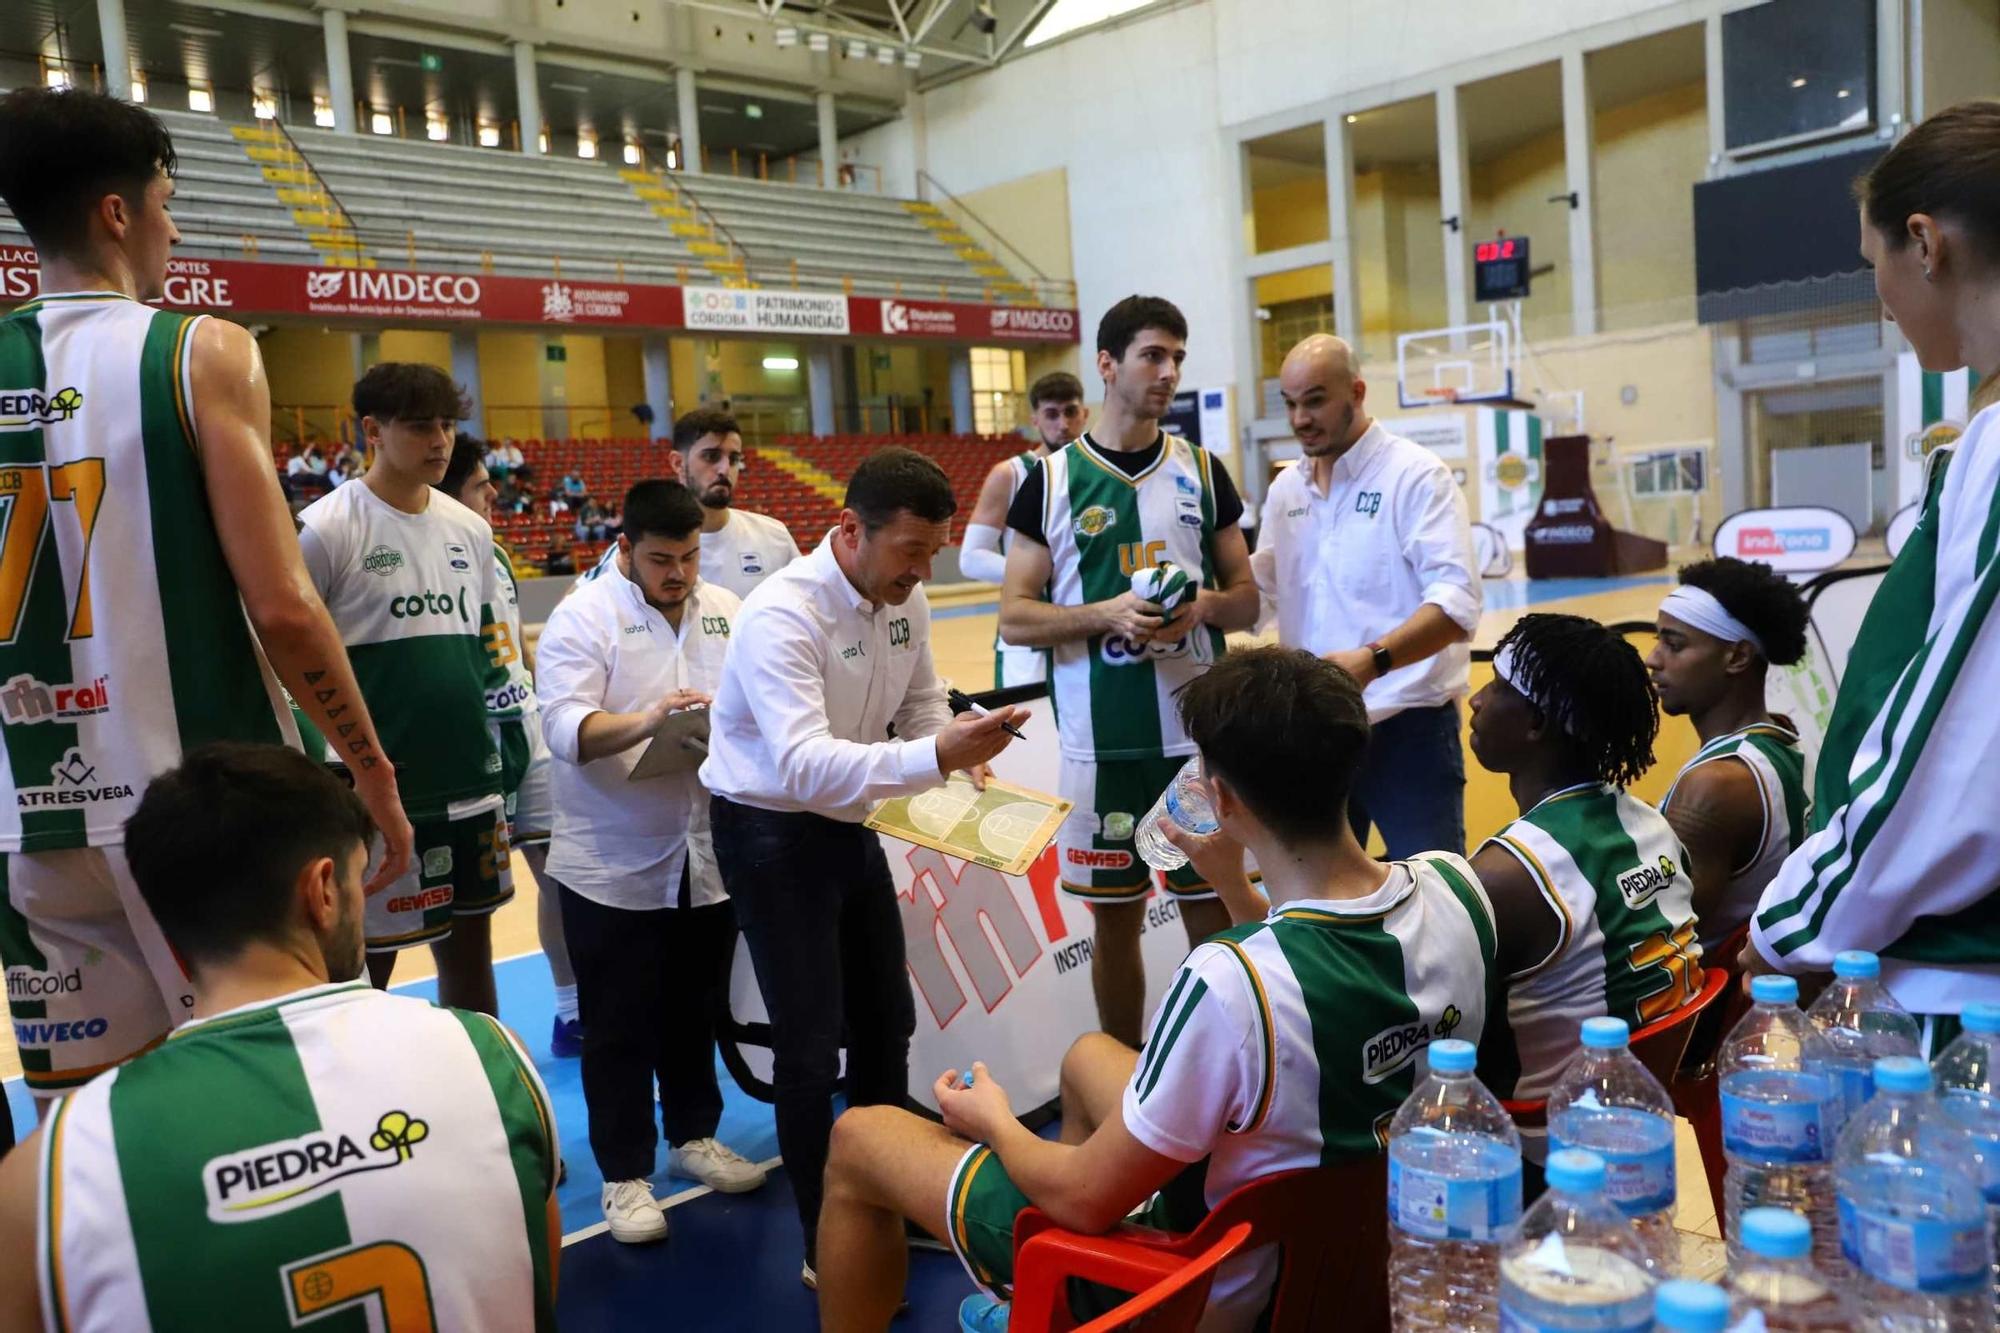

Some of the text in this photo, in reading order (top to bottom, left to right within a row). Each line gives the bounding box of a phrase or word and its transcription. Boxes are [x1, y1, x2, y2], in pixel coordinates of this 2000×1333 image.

[147, 276, 232, 306] GRE
[349, 271, 481, 304] IMDECO
[756, 296, 834, 310] PATRIMONIO
[757, 313, 845, 329] HUMANIDAD
[1008, 310, 1073, 331] IMDECO
[702, 617, 730, 635] CCB
[888, 617, 910, 646] CCB
